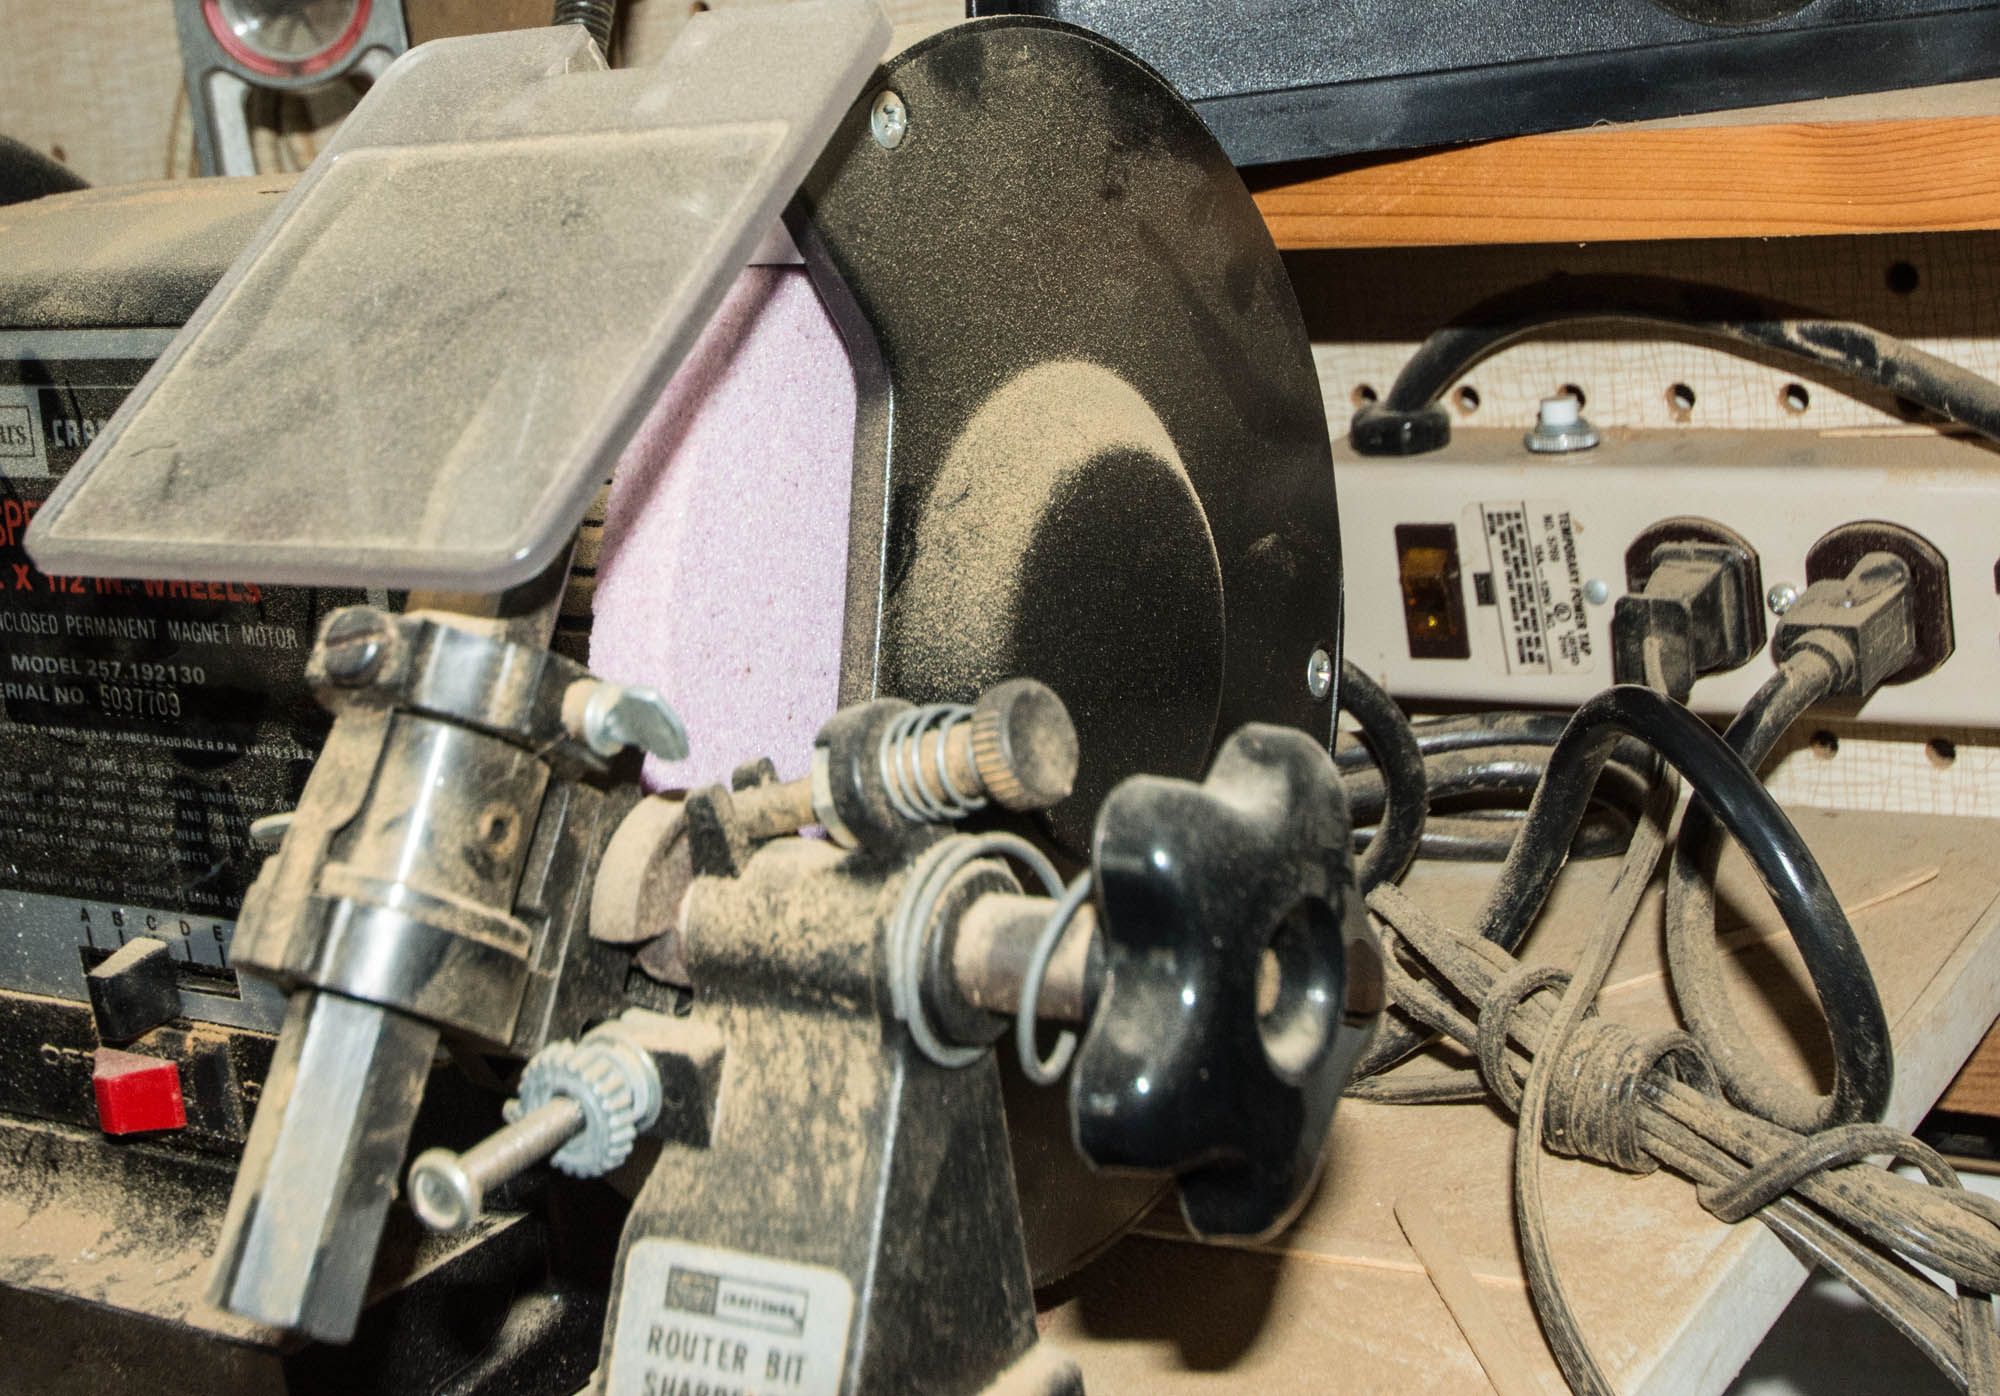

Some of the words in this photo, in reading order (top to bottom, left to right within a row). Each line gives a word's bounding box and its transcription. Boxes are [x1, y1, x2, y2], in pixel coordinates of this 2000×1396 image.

[11, 563, 33, 591] X
[65, 615, 158, 639] PERMANENT
[168, 620, 231, 645] MAGNET
[241, 623, 299, 650] MOTOR
[1578, 632, 1592, 656] TAP
[11, 655, 82, 676] MODEL
[80, 906, 91, 924] A
[111, 910, 124, 928] B
[145, 914, 158, 932] C
[179, 919, 191, 937] D
[212, 924, 224, 943] E
[647, 1324, 749, 1373] ROUTER
[765, 1345, 806, 1387] BIT
